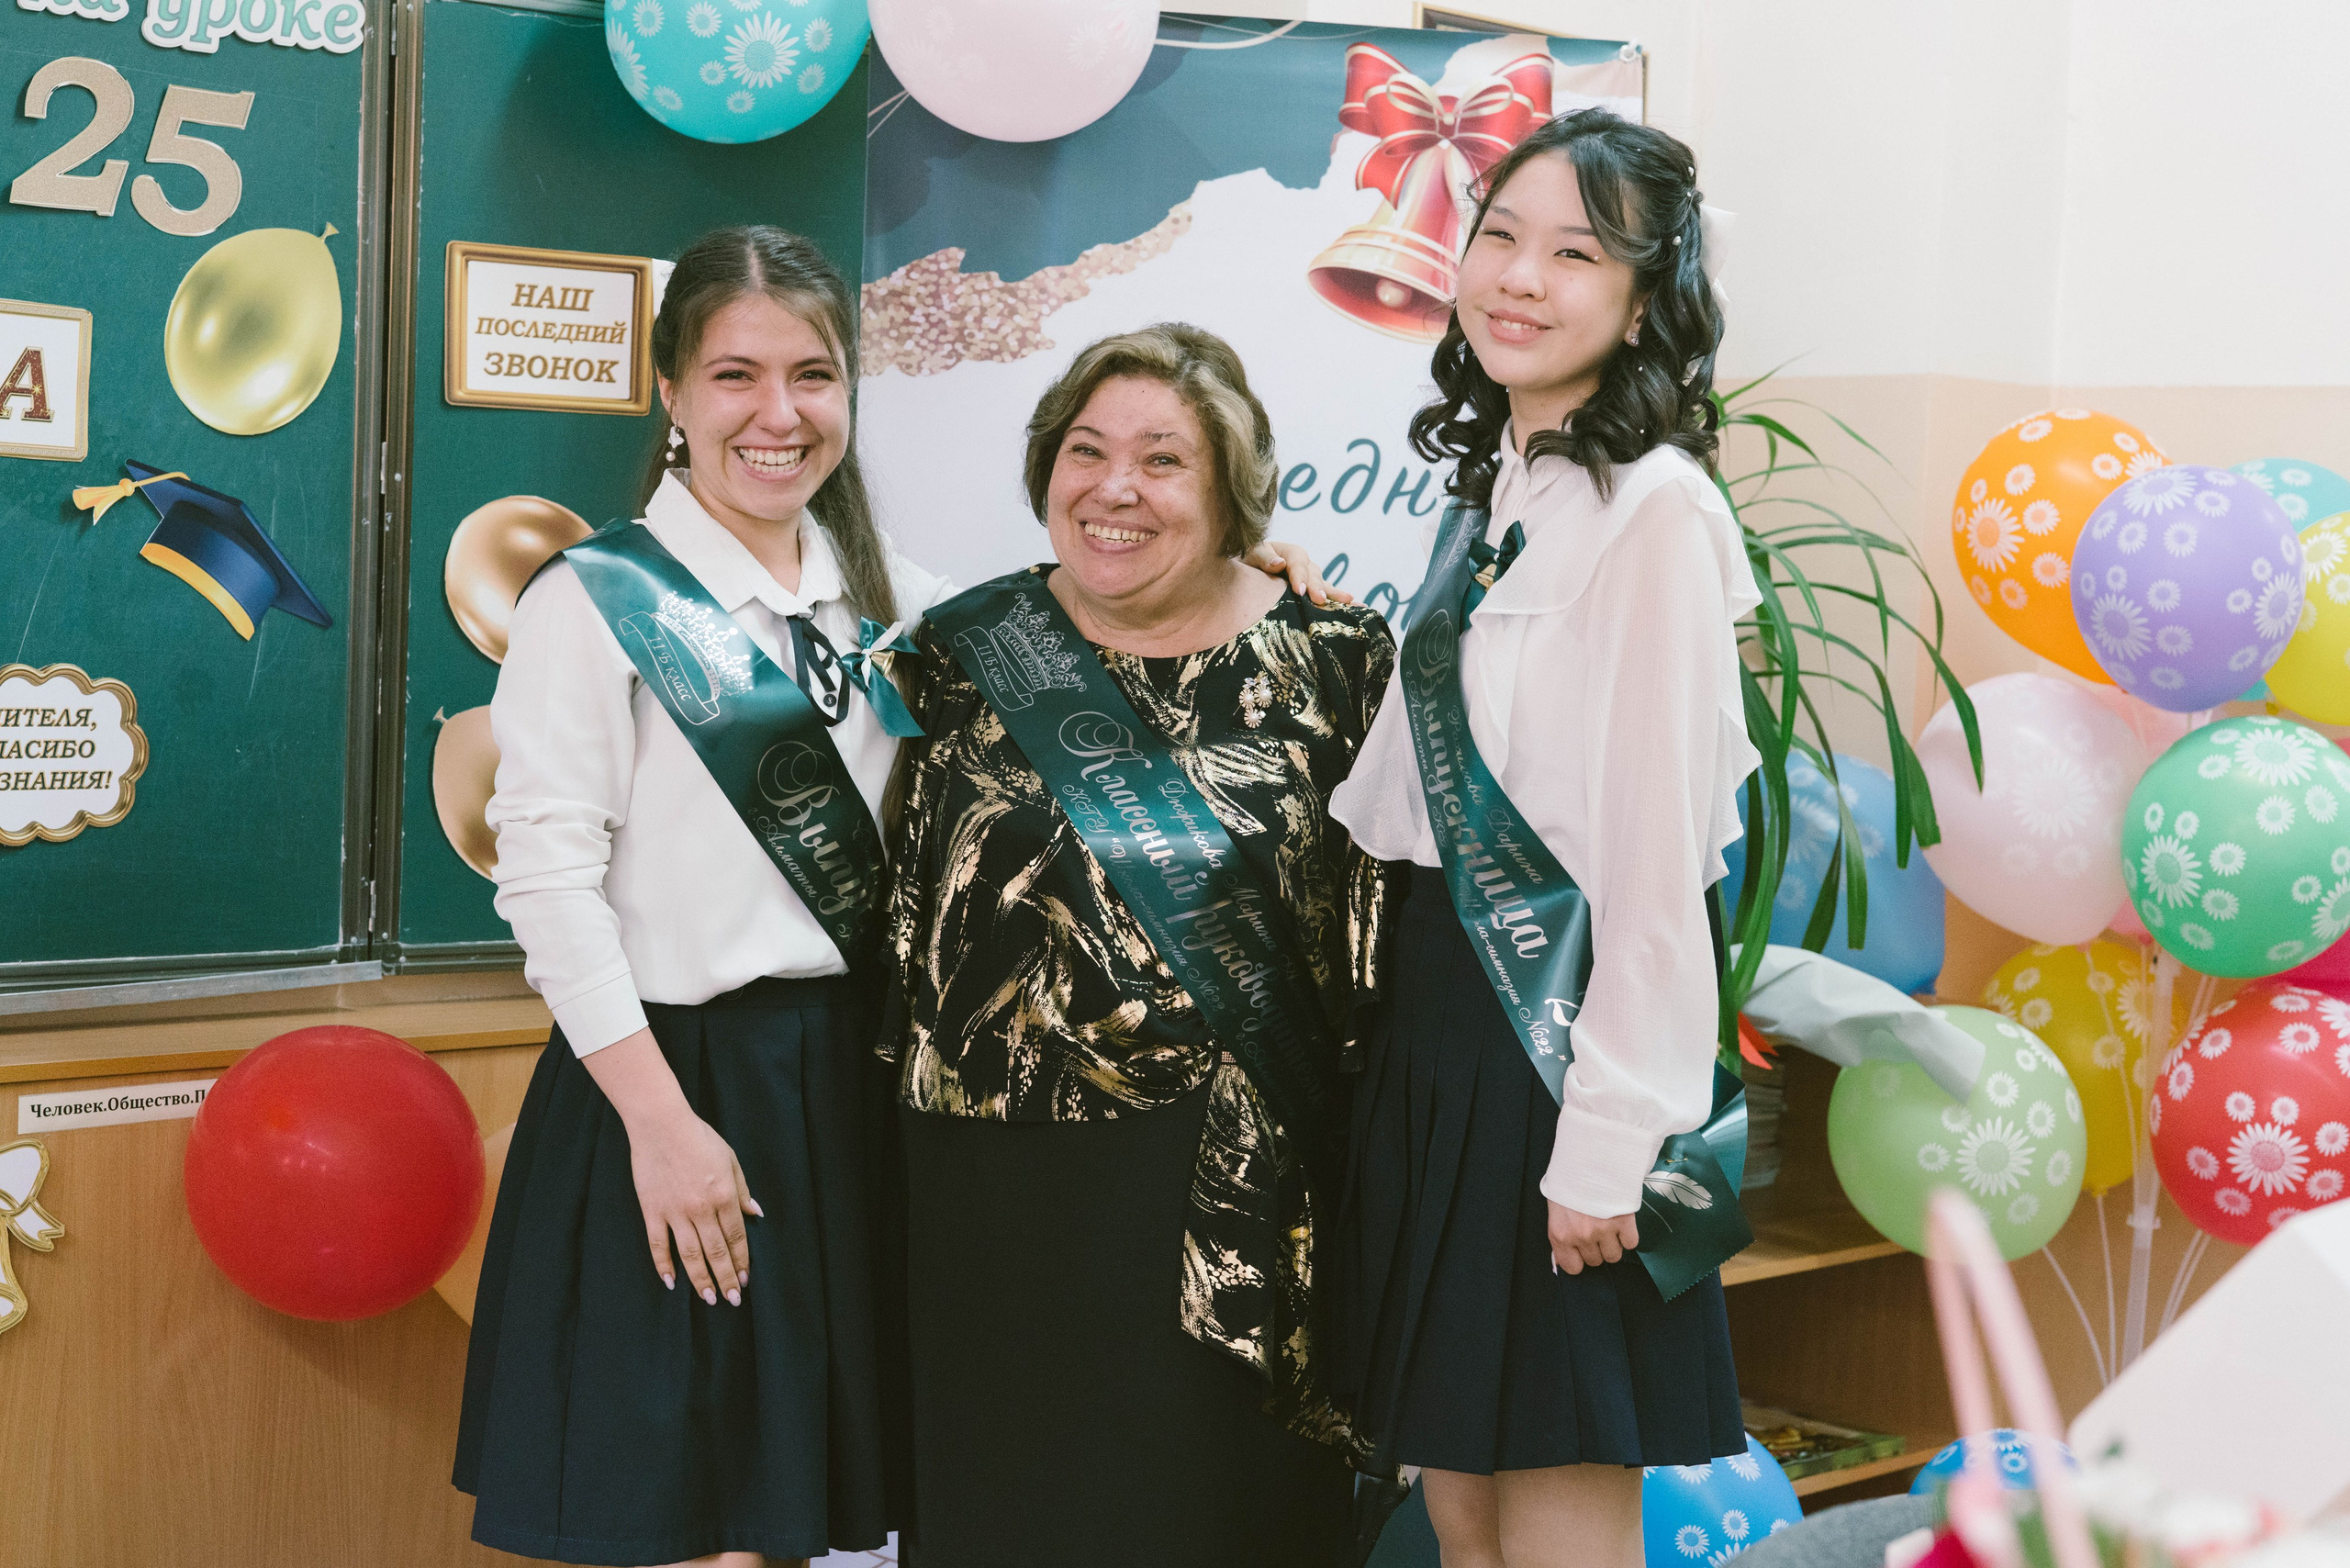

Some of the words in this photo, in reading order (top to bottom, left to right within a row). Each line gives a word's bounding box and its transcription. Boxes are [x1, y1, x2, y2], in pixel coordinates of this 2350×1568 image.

[510, 283, 595, 312] НАШ
[475, 317, 628, 345] ПОСЛЕДНИЙ
[483, 352, 620, 384] ЗВОНОК
[1278, 438, 1438, 517] едн
[665, 666, 692, 701] класс
[988, 666, 1010, 694] класс
[0, 708, 97, 731] ИТЕЛЯ,
[0, 770, 113, 791] ЗНАНИЯ!
[1416, 608, 1550, 959] Выпускница
[1058, 711, 1210, 902] Классный
[1062, 784, 1116, 834] КГУ
[755, 815, 818, 900] Алматы
[1484, 805, 1544, 885] Дарина
[1222, 873, 1278, 952] Марина
[30, 1089, 208, 1118] Человек.Общество.П
